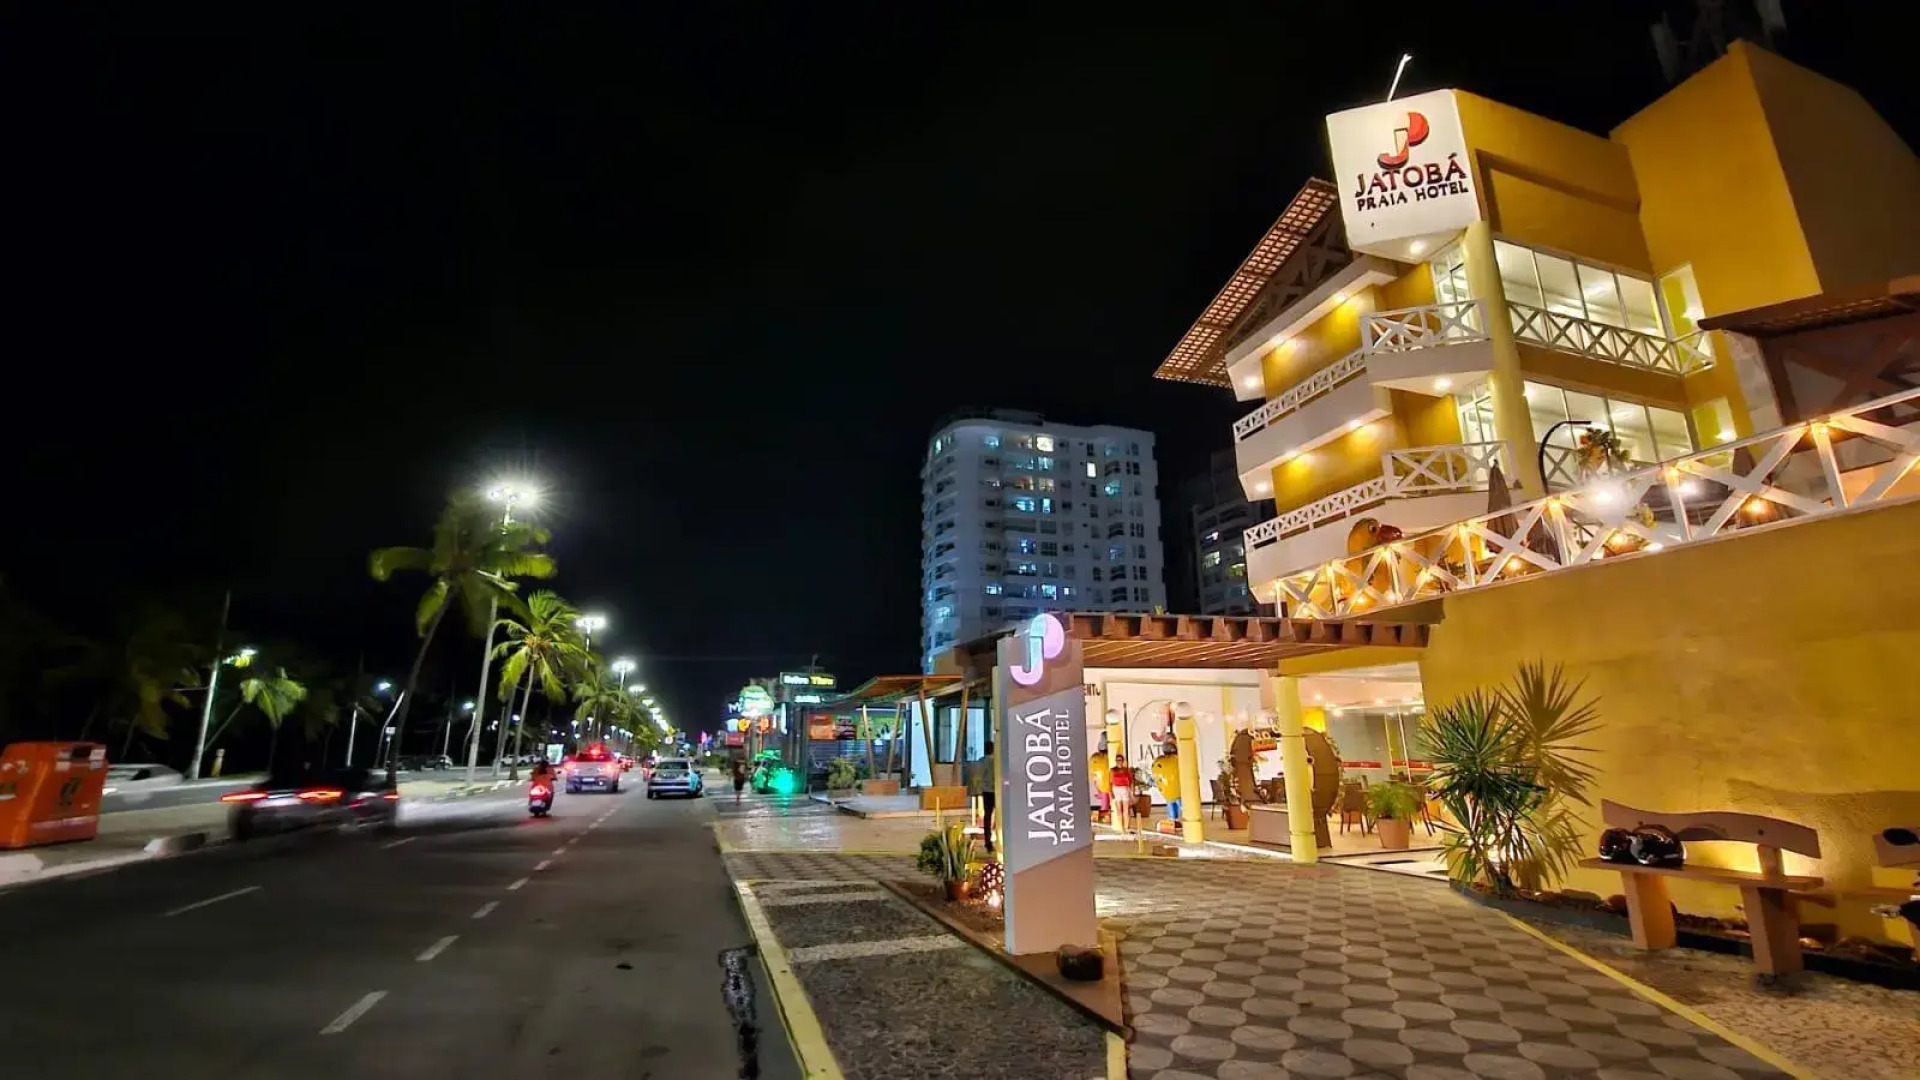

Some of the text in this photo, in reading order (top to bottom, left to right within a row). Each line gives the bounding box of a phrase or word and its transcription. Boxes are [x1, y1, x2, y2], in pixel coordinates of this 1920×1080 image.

[1355, 152, 1467, 198] JATOBÁ
[1357, 180, 1469, 211] PRAIA HOTEL
[1016, 707, 1057, 845] JATOBÁ
[1055, 708, 1076, 843] PRAIA HOTEL
